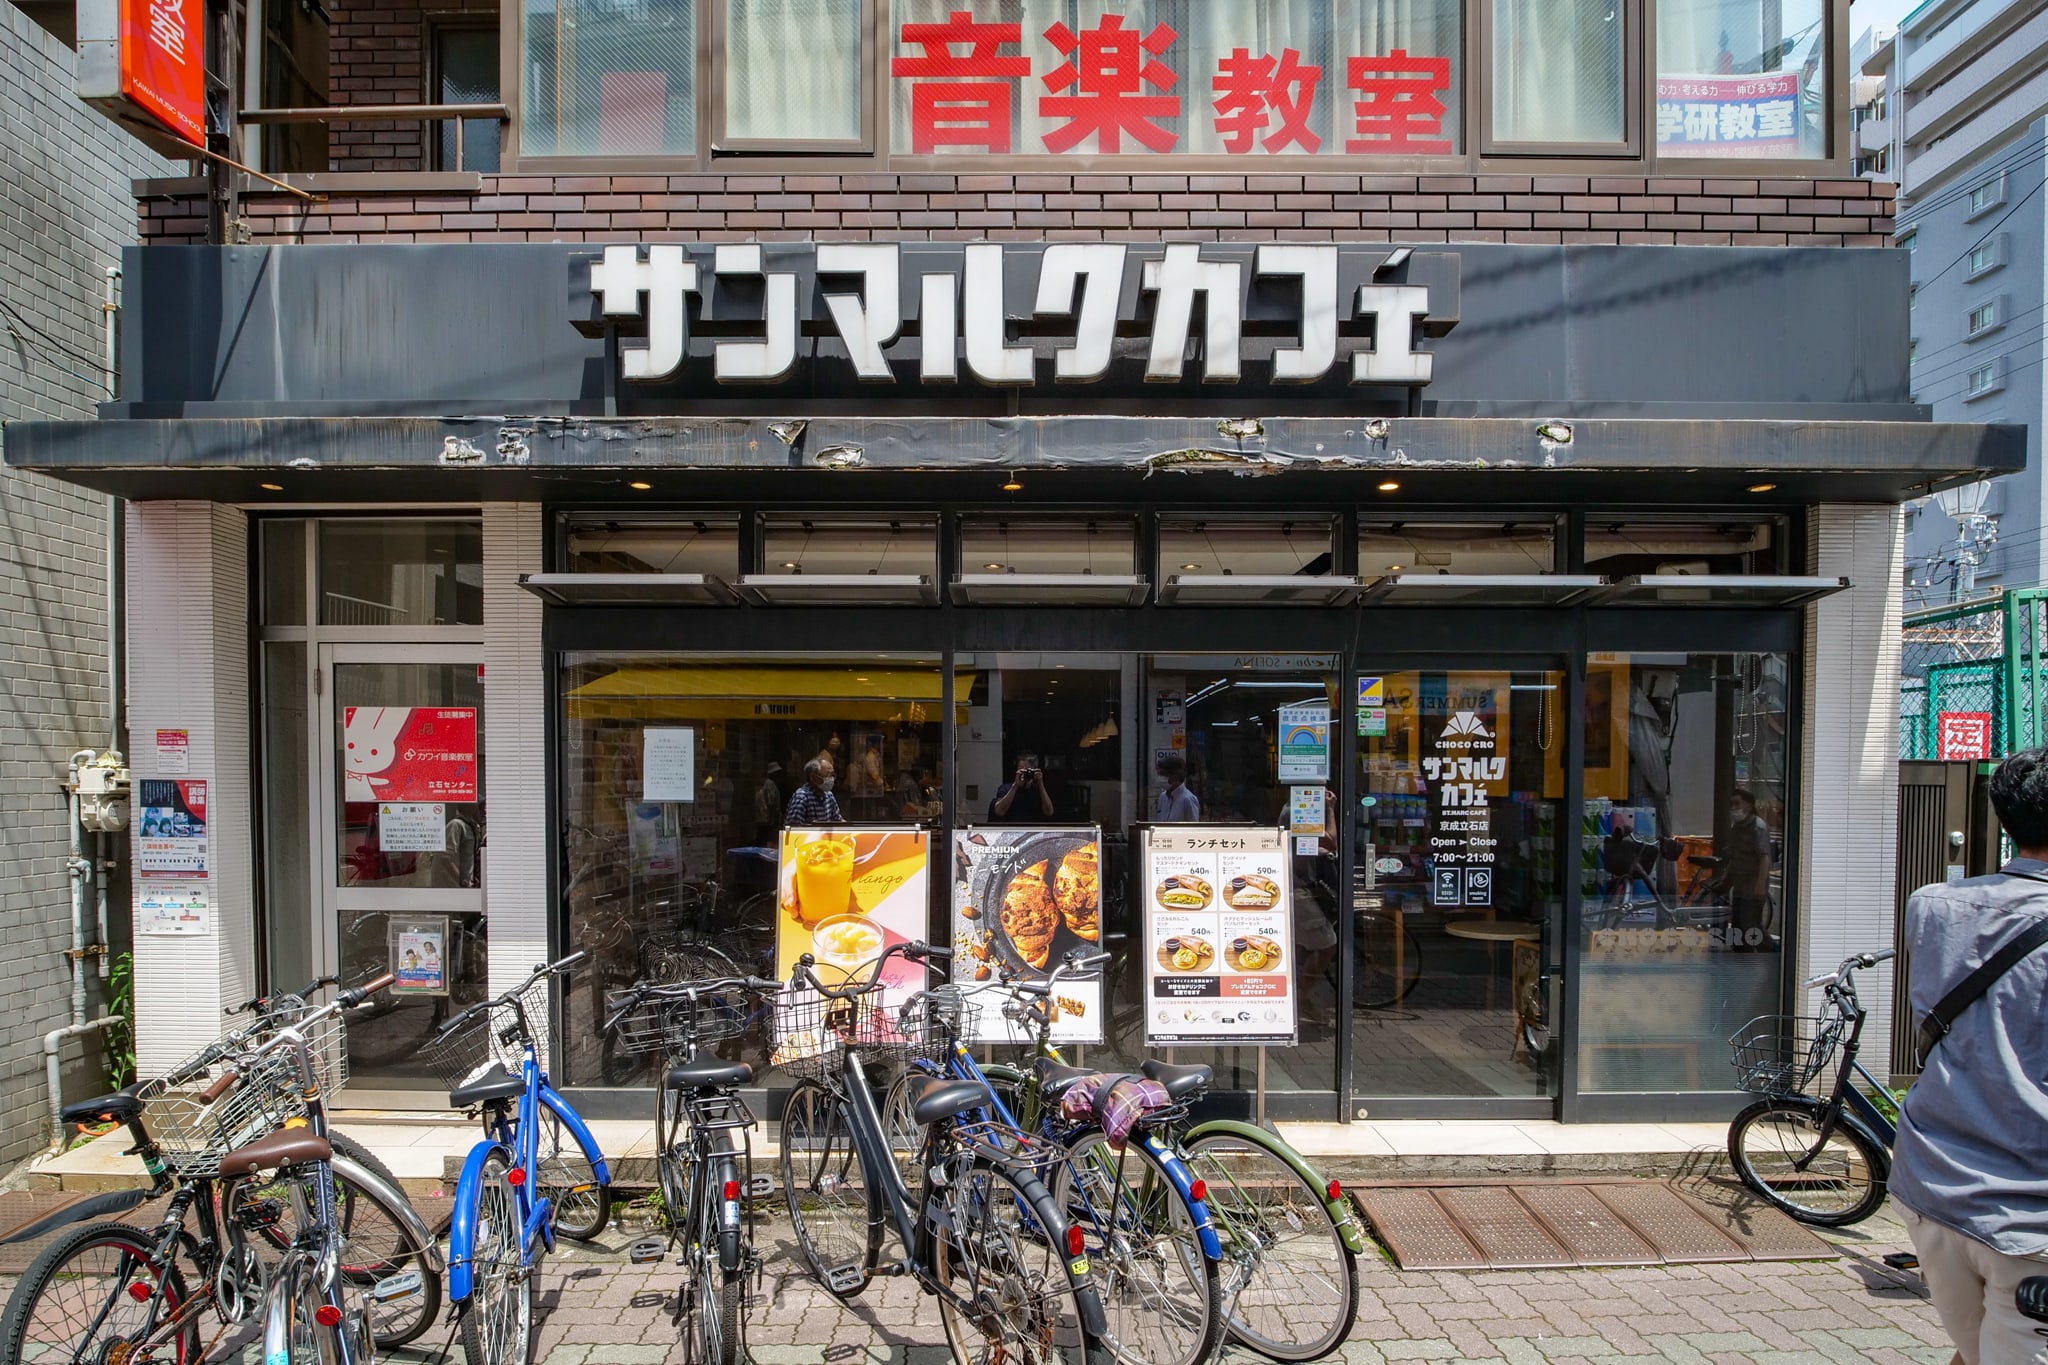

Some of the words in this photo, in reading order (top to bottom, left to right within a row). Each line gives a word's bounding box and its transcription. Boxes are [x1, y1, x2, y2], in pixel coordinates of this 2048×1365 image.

[891, 11, 1453, 155] 音楽教室
[132, 76, 156, 99] KAWAI
[155, 93, 177, 115] MUSIC
[177, 110, 203, 135] SCHOOL
[1656, 100, 1795, 142] 学研教室
[590, 243, 1435, 385] サンマルクカフェ
[1435, 741, 1471, 749] CHOCO
[1473, 741, 1494, 749] CRO
[417, 752, 473, 762] カワイ音楽教室
[1422, 757, 1506, 780] サンマルク
[428, 781, 473, 789] 立石センター
[1440, 783, 1488, 807] カフェ
[1440, 821, 1489, 831] 京成立石店
[971, 846, 1020, 854] PREMIUM
[1187, 838, 1246, 849] ランチセット
[1430, 837, 1456, 850] Open
[1470, 837, 1497, 847] Close
[965, 858, 1028, 874] アーモンド
[1597, 927, 1699, 947] CHOCO
[1707, 927, 1764, 947] CRO
